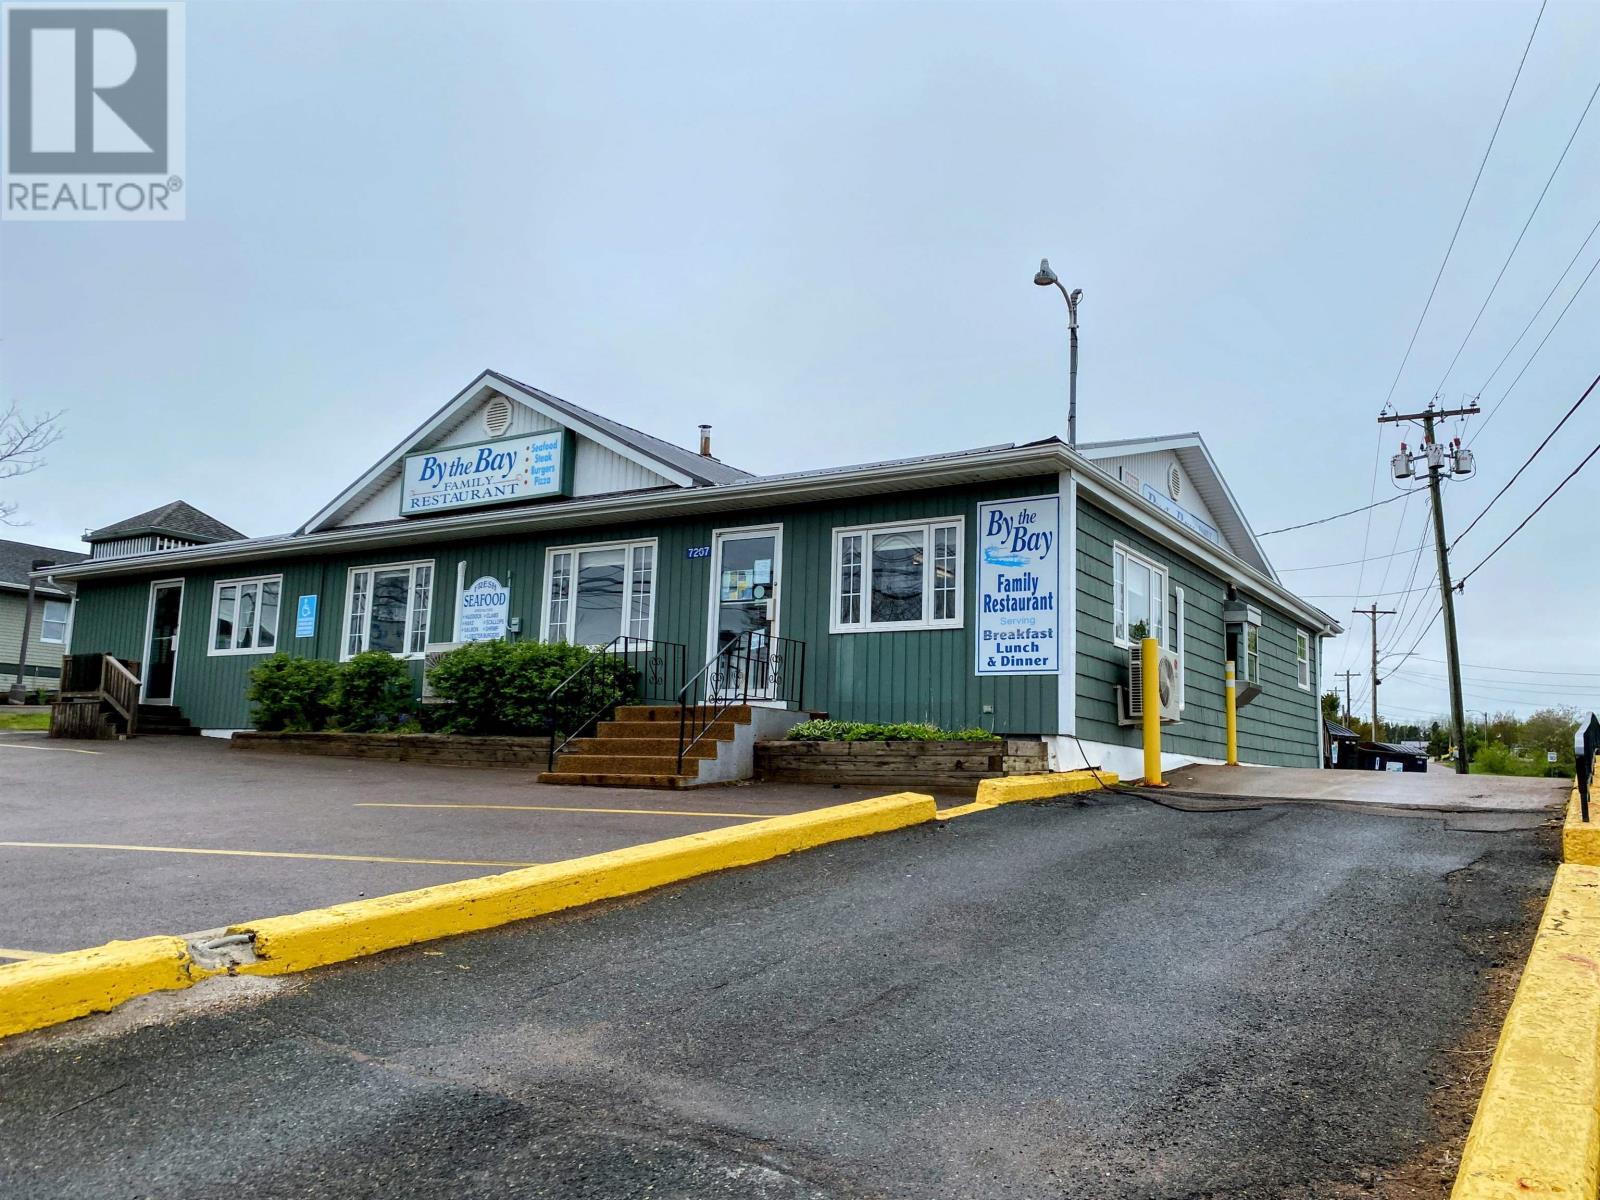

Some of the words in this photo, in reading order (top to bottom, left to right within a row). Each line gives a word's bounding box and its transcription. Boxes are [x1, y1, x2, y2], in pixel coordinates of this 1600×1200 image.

[531, 440, 558, 452] Seafood
[534, 452, 552, 463] Steak
[418, 456, 447, 489] By
[450, 457, 473, 477] the
[473, 447, 517, 479] Bay
[531, 465, 555, 475] Burgers
[444, 475, 493, 492] FAMILY
[534, 477, 551, 486] Pizza
[410, 483, 519, 509] RESTAURANT
[986, 509, 1014, 545] By
[1017, 508, 1037, 525] the
[1010, 526, 1053, 560] Bay
[688, 546, 710, 558] 7207
[474, 580, 497, 592] FRESH
[997, 572, 1039, 595] Family
[463, 592, 506, 608] SEAFOOD
[983, 591, 1054, 613] Restaurant
[1000, 616, 1036, 625] Serving
[983, 628, 1054, 641] Breakfast
[996, 642, 1039, 653] Lunch
[987, 656, 997, 667] &
[1001, 656, 1049, 667] Dinner
